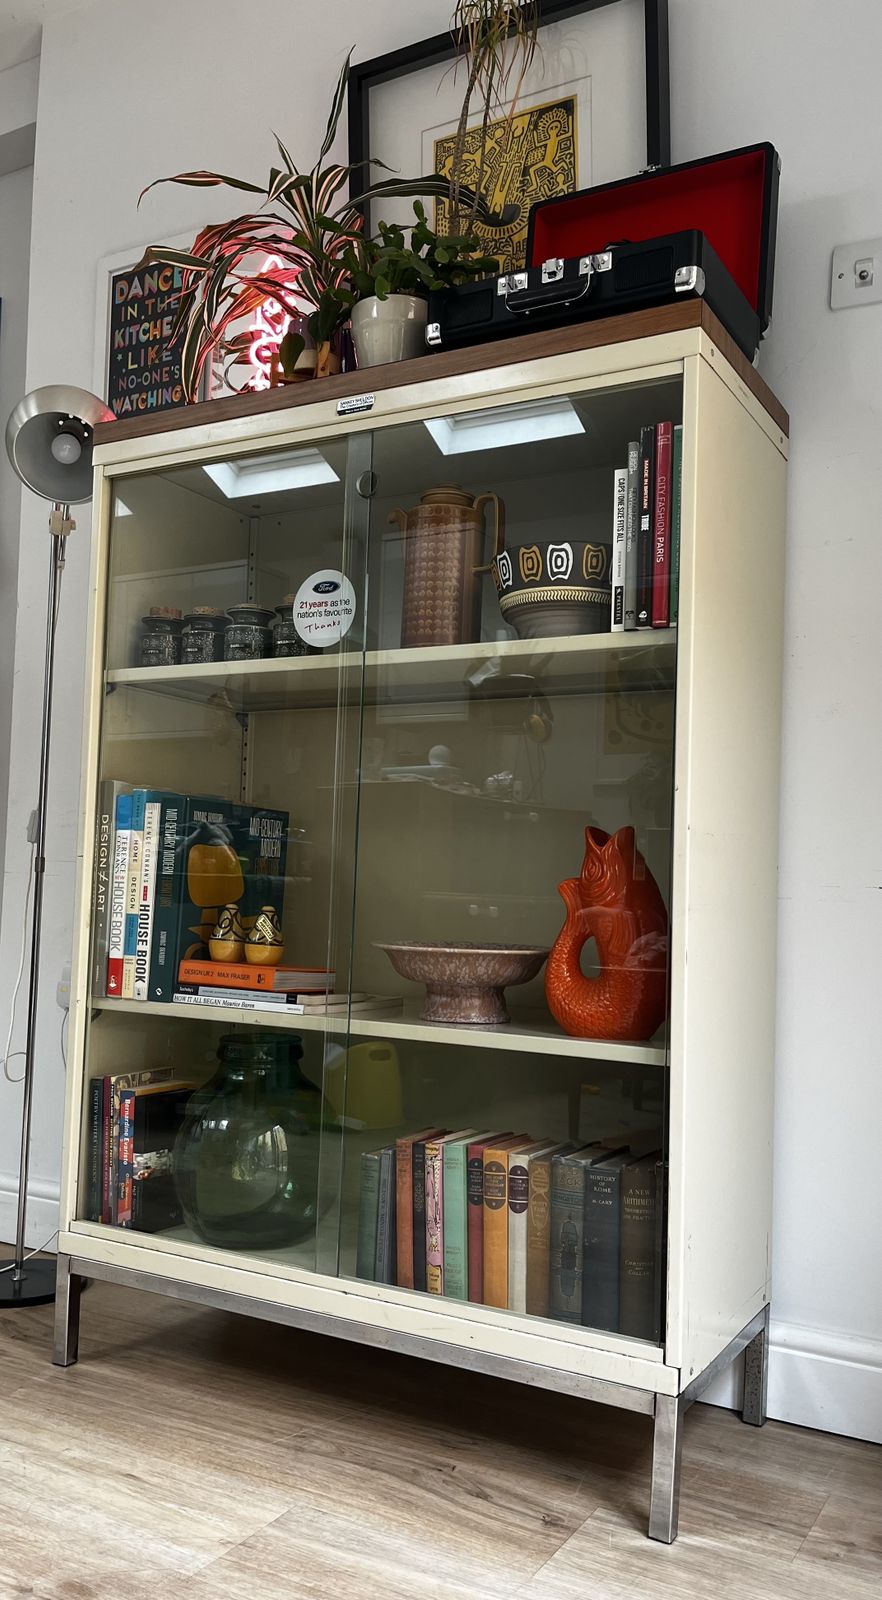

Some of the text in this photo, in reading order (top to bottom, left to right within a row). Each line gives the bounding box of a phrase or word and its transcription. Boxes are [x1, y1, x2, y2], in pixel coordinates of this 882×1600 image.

[121, 292, 181, 322] IN THE
[114, 315, 184, 350] KITCHE
[127, 342, 173, 370] LIKE
[118, 364, 181, 392] NO-ONE'S
[112, 385, 183, 415] WATCHING
[617, 477, 625, 493] CAPS
[617, 496, 625, 506] ONE
[617, 506, 625, 519] SIZE
[616, 519, 625, 532] FITS
[641, 514, 649, 531] TRIBE
[656, 476, 666, 563] CITY FASHION PARIS
[616, 533, 624, 543] ALL
[318, 583, 334, 591] Ford
[297, 607, 353, 619] nation's favourite
[299, 601, 308, 609] 21
[309, 600, 328, 610] years
[304, 620, 341, 634] Thanks
[99, 814, 109, 868] DESIGN
[120, 835, 128, 874] TERENCE
[162, 849, 175, 875] MODERN
[97, 884, 106, 913] ART
[112, 881, 124, 918] HOUSE
[110, 920, 123, 952] BOOK
[135, 904, 150, 983] HOUSE BOOK
[174, 994, 187, 1002] HOW
[193, 996, 202, 1004] ALL
[202, 997, 222, 1005] BEGAN
[122, 1099, 131, 1166] Bernardine Evaristo
[590, 1174, 617, 1182] HISTORY
[593, 1186, 612, 1194] ROME
